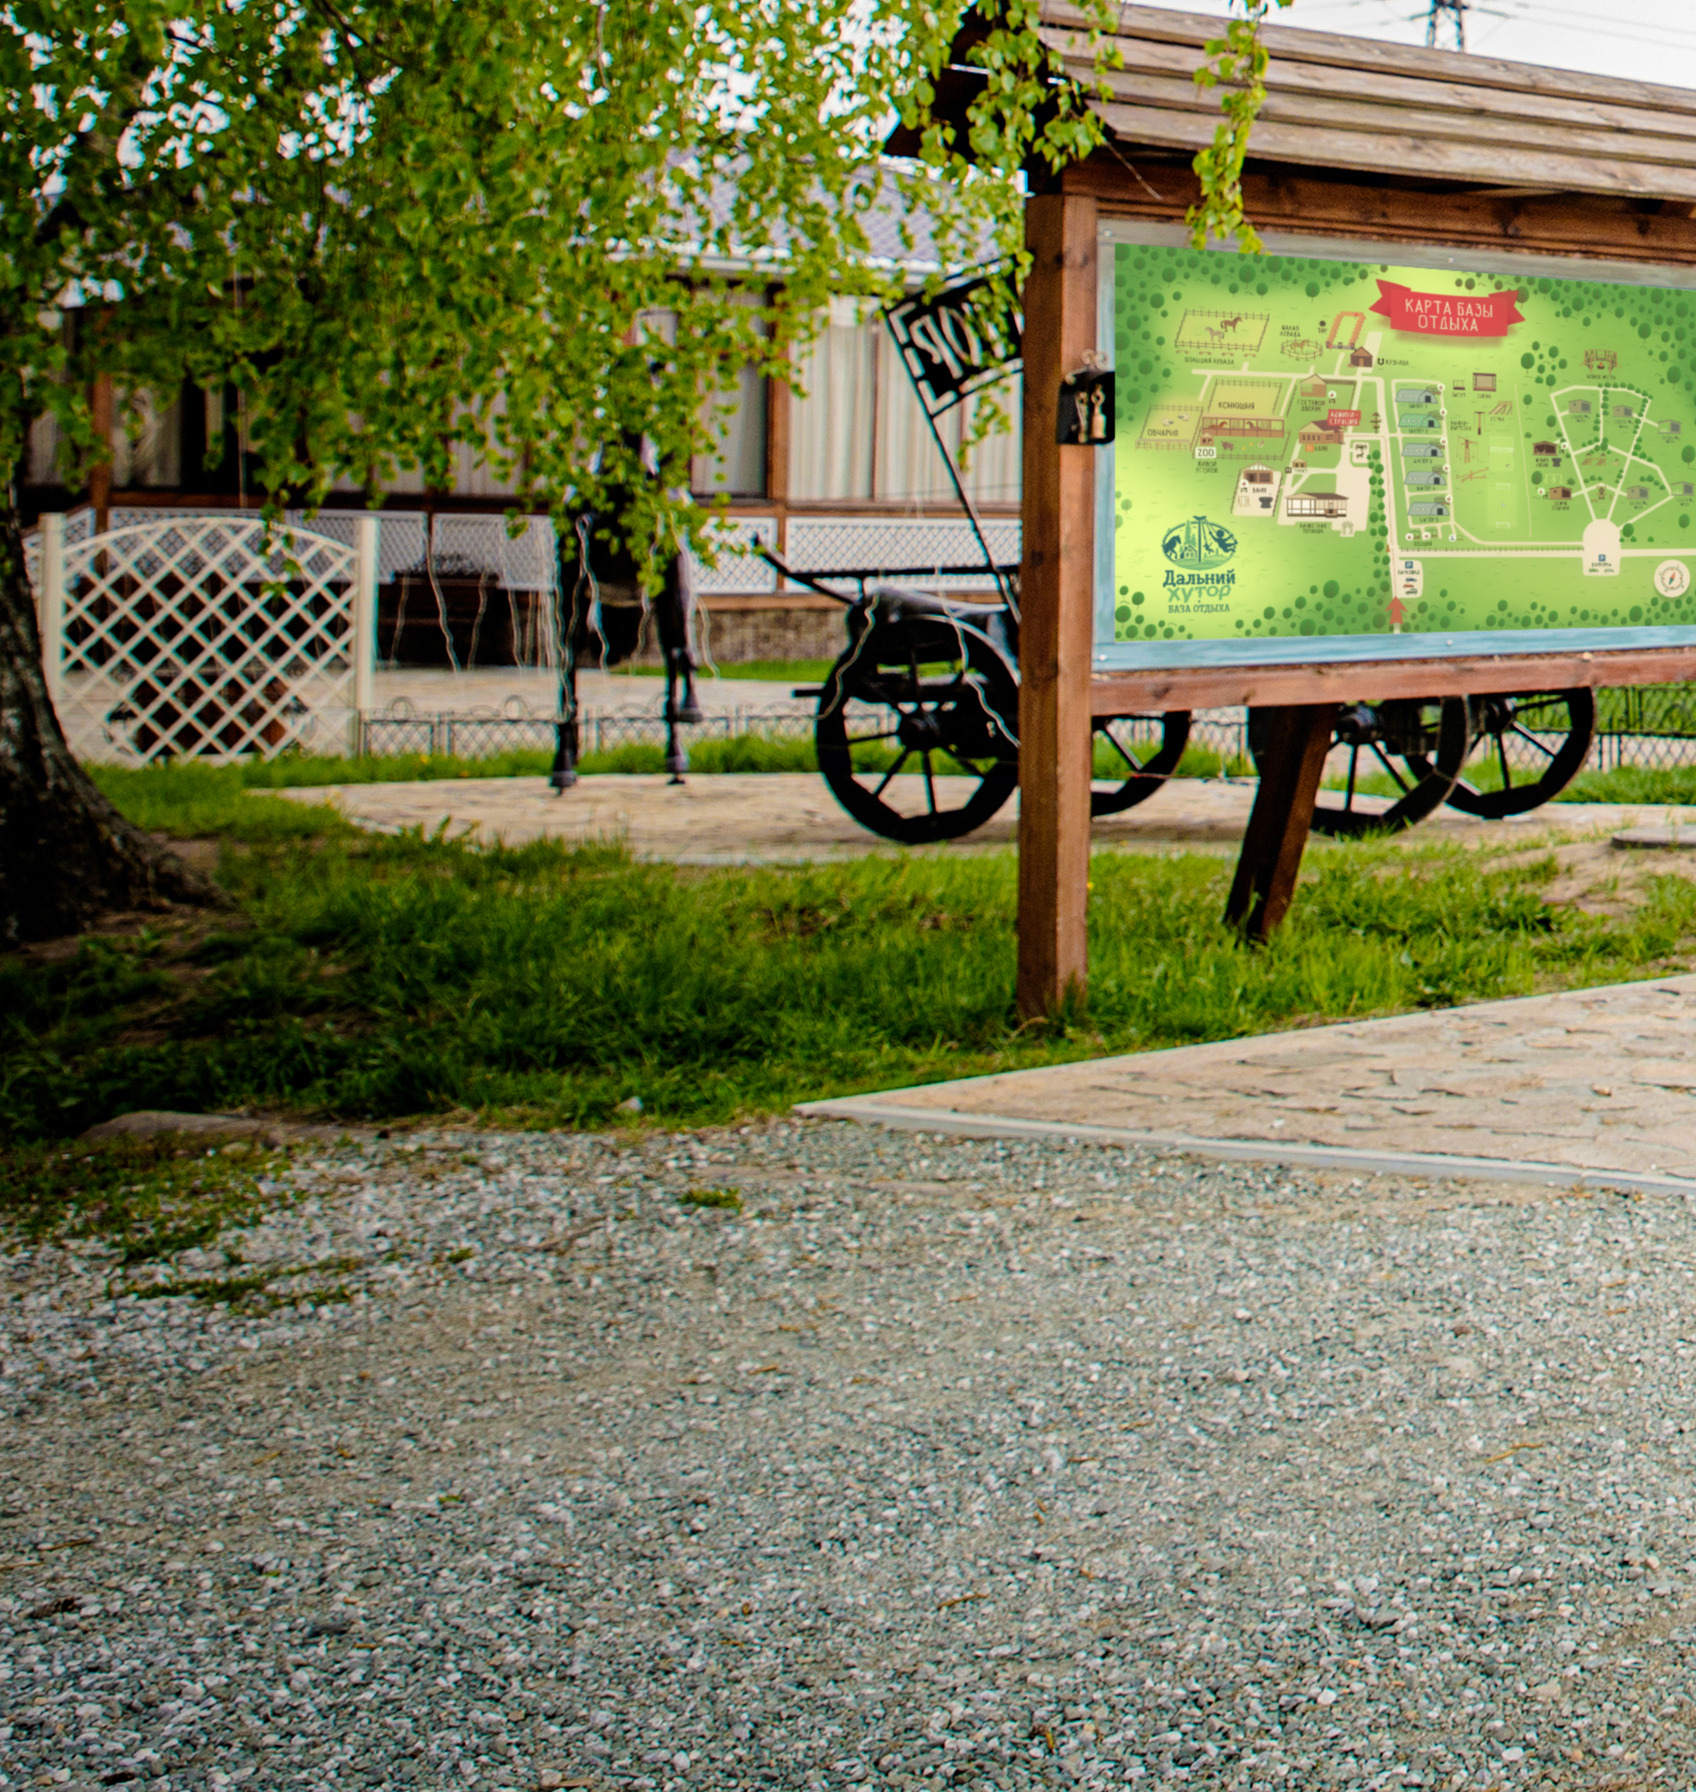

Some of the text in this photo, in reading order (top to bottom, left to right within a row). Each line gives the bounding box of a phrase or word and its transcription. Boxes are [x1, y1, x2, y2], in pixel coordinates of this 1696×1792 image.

[1405, 298, 1493, 318] КАРТА БАЗЫ
[1418, 314, 1479, 332] ОТДЫХА
[1218, 401, 1255, 410] КОНЮШНЯ
[1147, 429, 1179, 437] ОВЧАРНЯ
[1197, 448, 1214, 457] ZOO
[1163, 569, 1236, 587] Дальний
[1168, 604, 1230, 613] БАЗА ОТДЫХА
